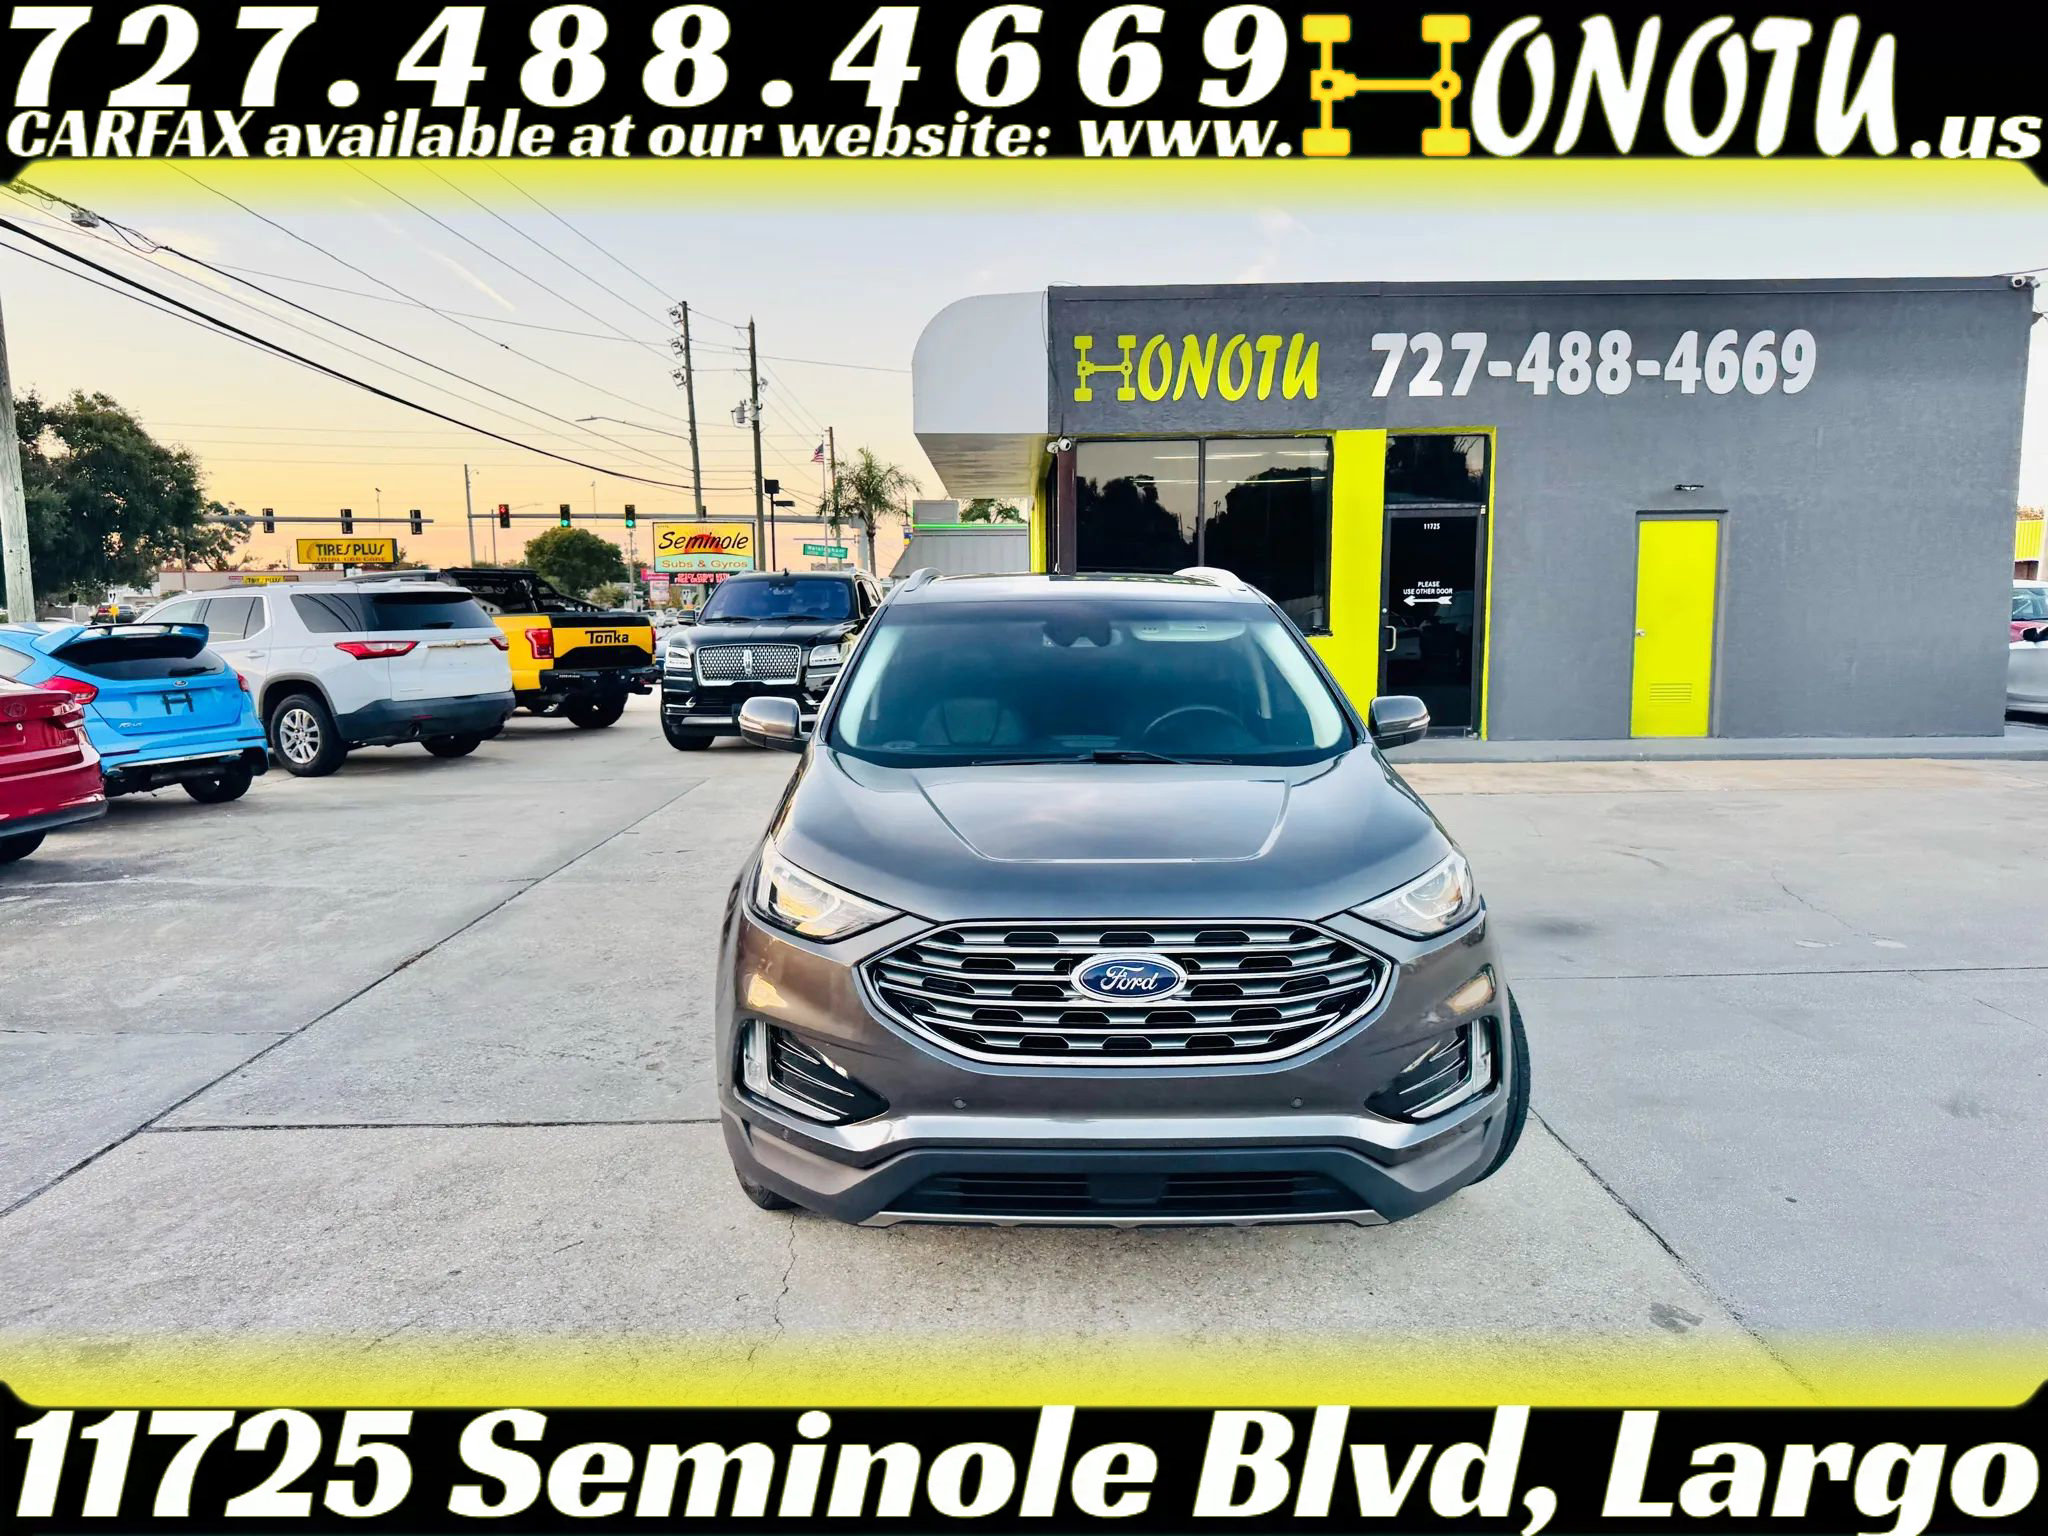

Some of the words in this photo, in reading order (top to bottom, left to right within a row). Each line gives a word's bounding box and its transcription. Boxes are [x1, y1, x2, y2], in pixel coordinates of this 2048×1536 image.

[1371, 329, 1817, 397] 727-488-4669
[658, 531, 749, 550] Seminole
[315, 543, 351, 556] TIRES
[353, 543, 385, 556] PLUS
[661, 559, 694, 569] Subs
[697, 559, 707, 569] &
[710, 559, 749, 570] Gyros
[585, 630, 629, 644] Tonka
[1100, 965, 1160, 990] Ford
